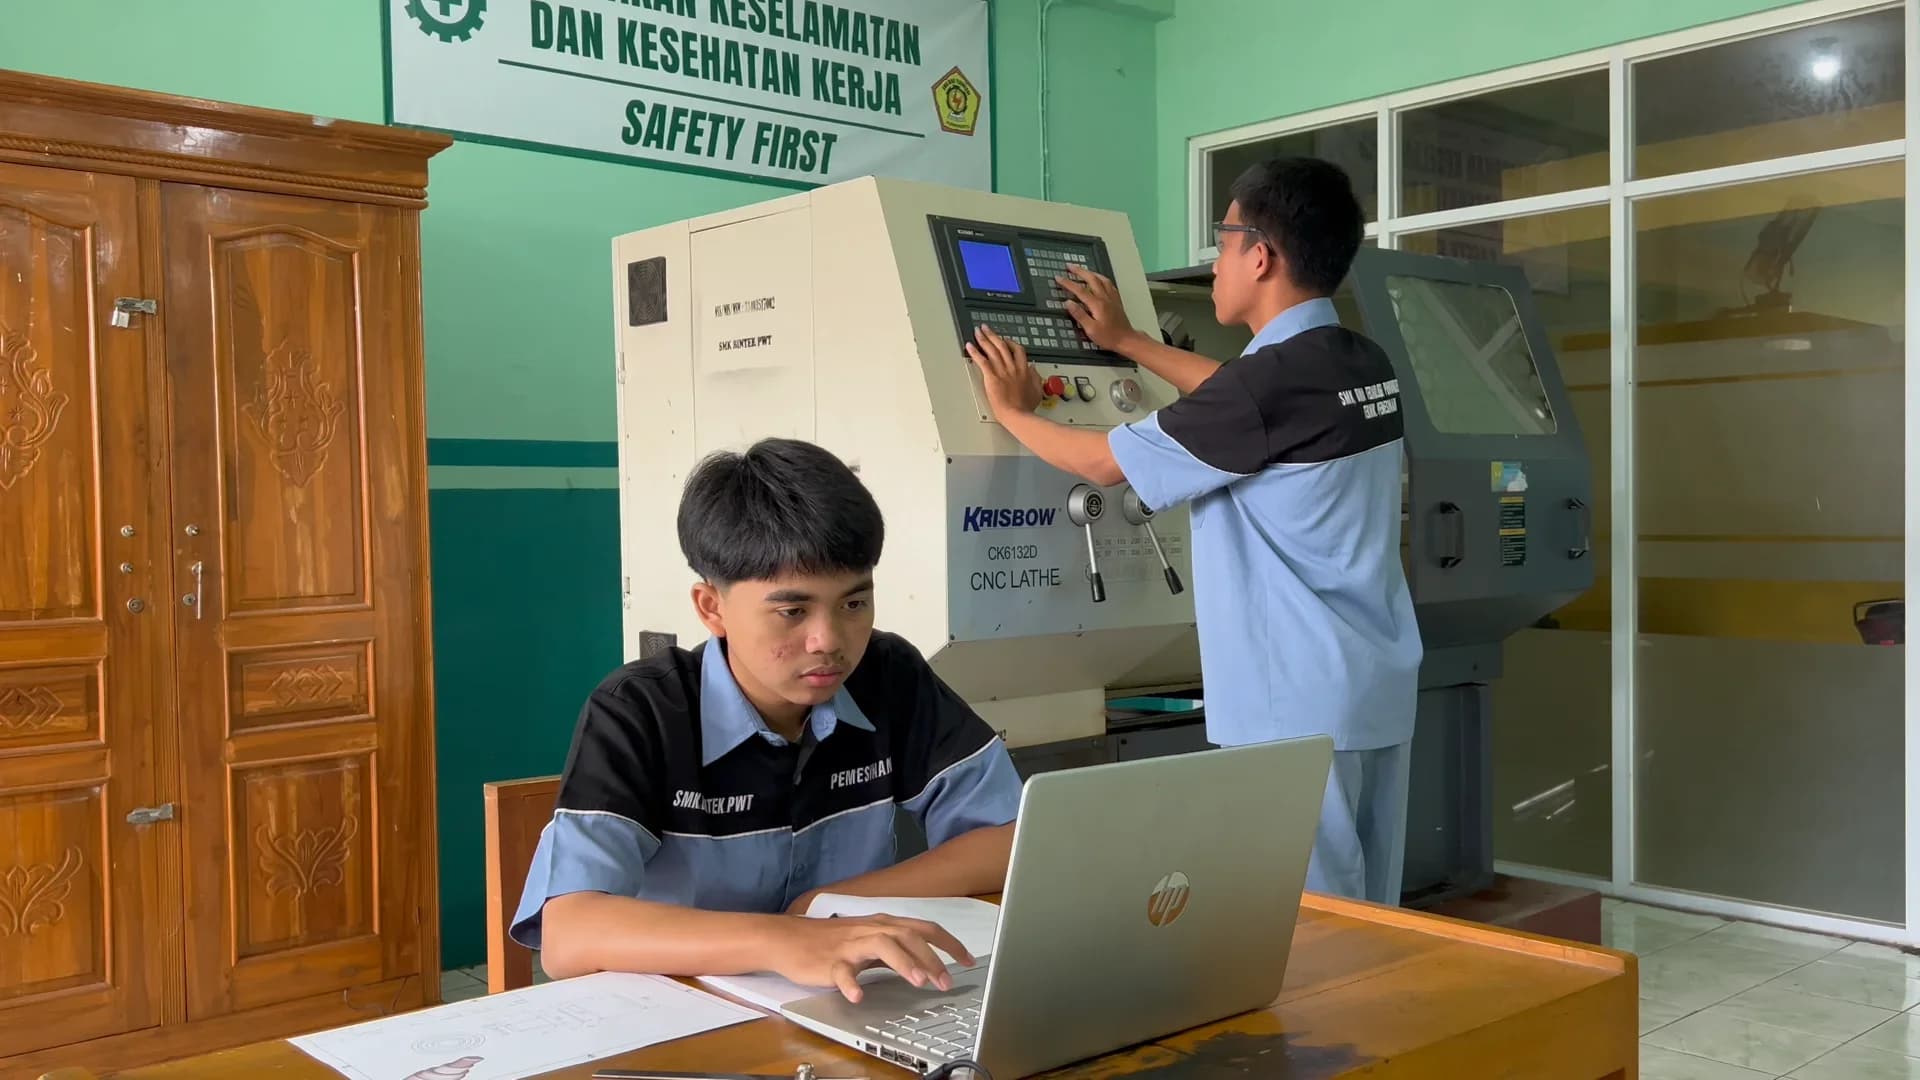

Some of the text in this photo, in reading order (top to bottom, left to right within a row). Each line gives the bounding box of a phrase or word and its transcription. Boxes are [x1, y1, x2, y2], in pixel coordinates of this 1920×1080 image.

[530, 0, 902, 116] DAN KESEHATAN KERJA
[621, 99, 838, 175] SAFETY FIRST
[963, 506, 1057, 532] KRISBOW
[987, 544, 1038, 560] CK6132D
[970, 567, 1061, 591] CNC LATHE
[672, 789, 702, 809] SMK
[727, 794, 754, 813] PWT
